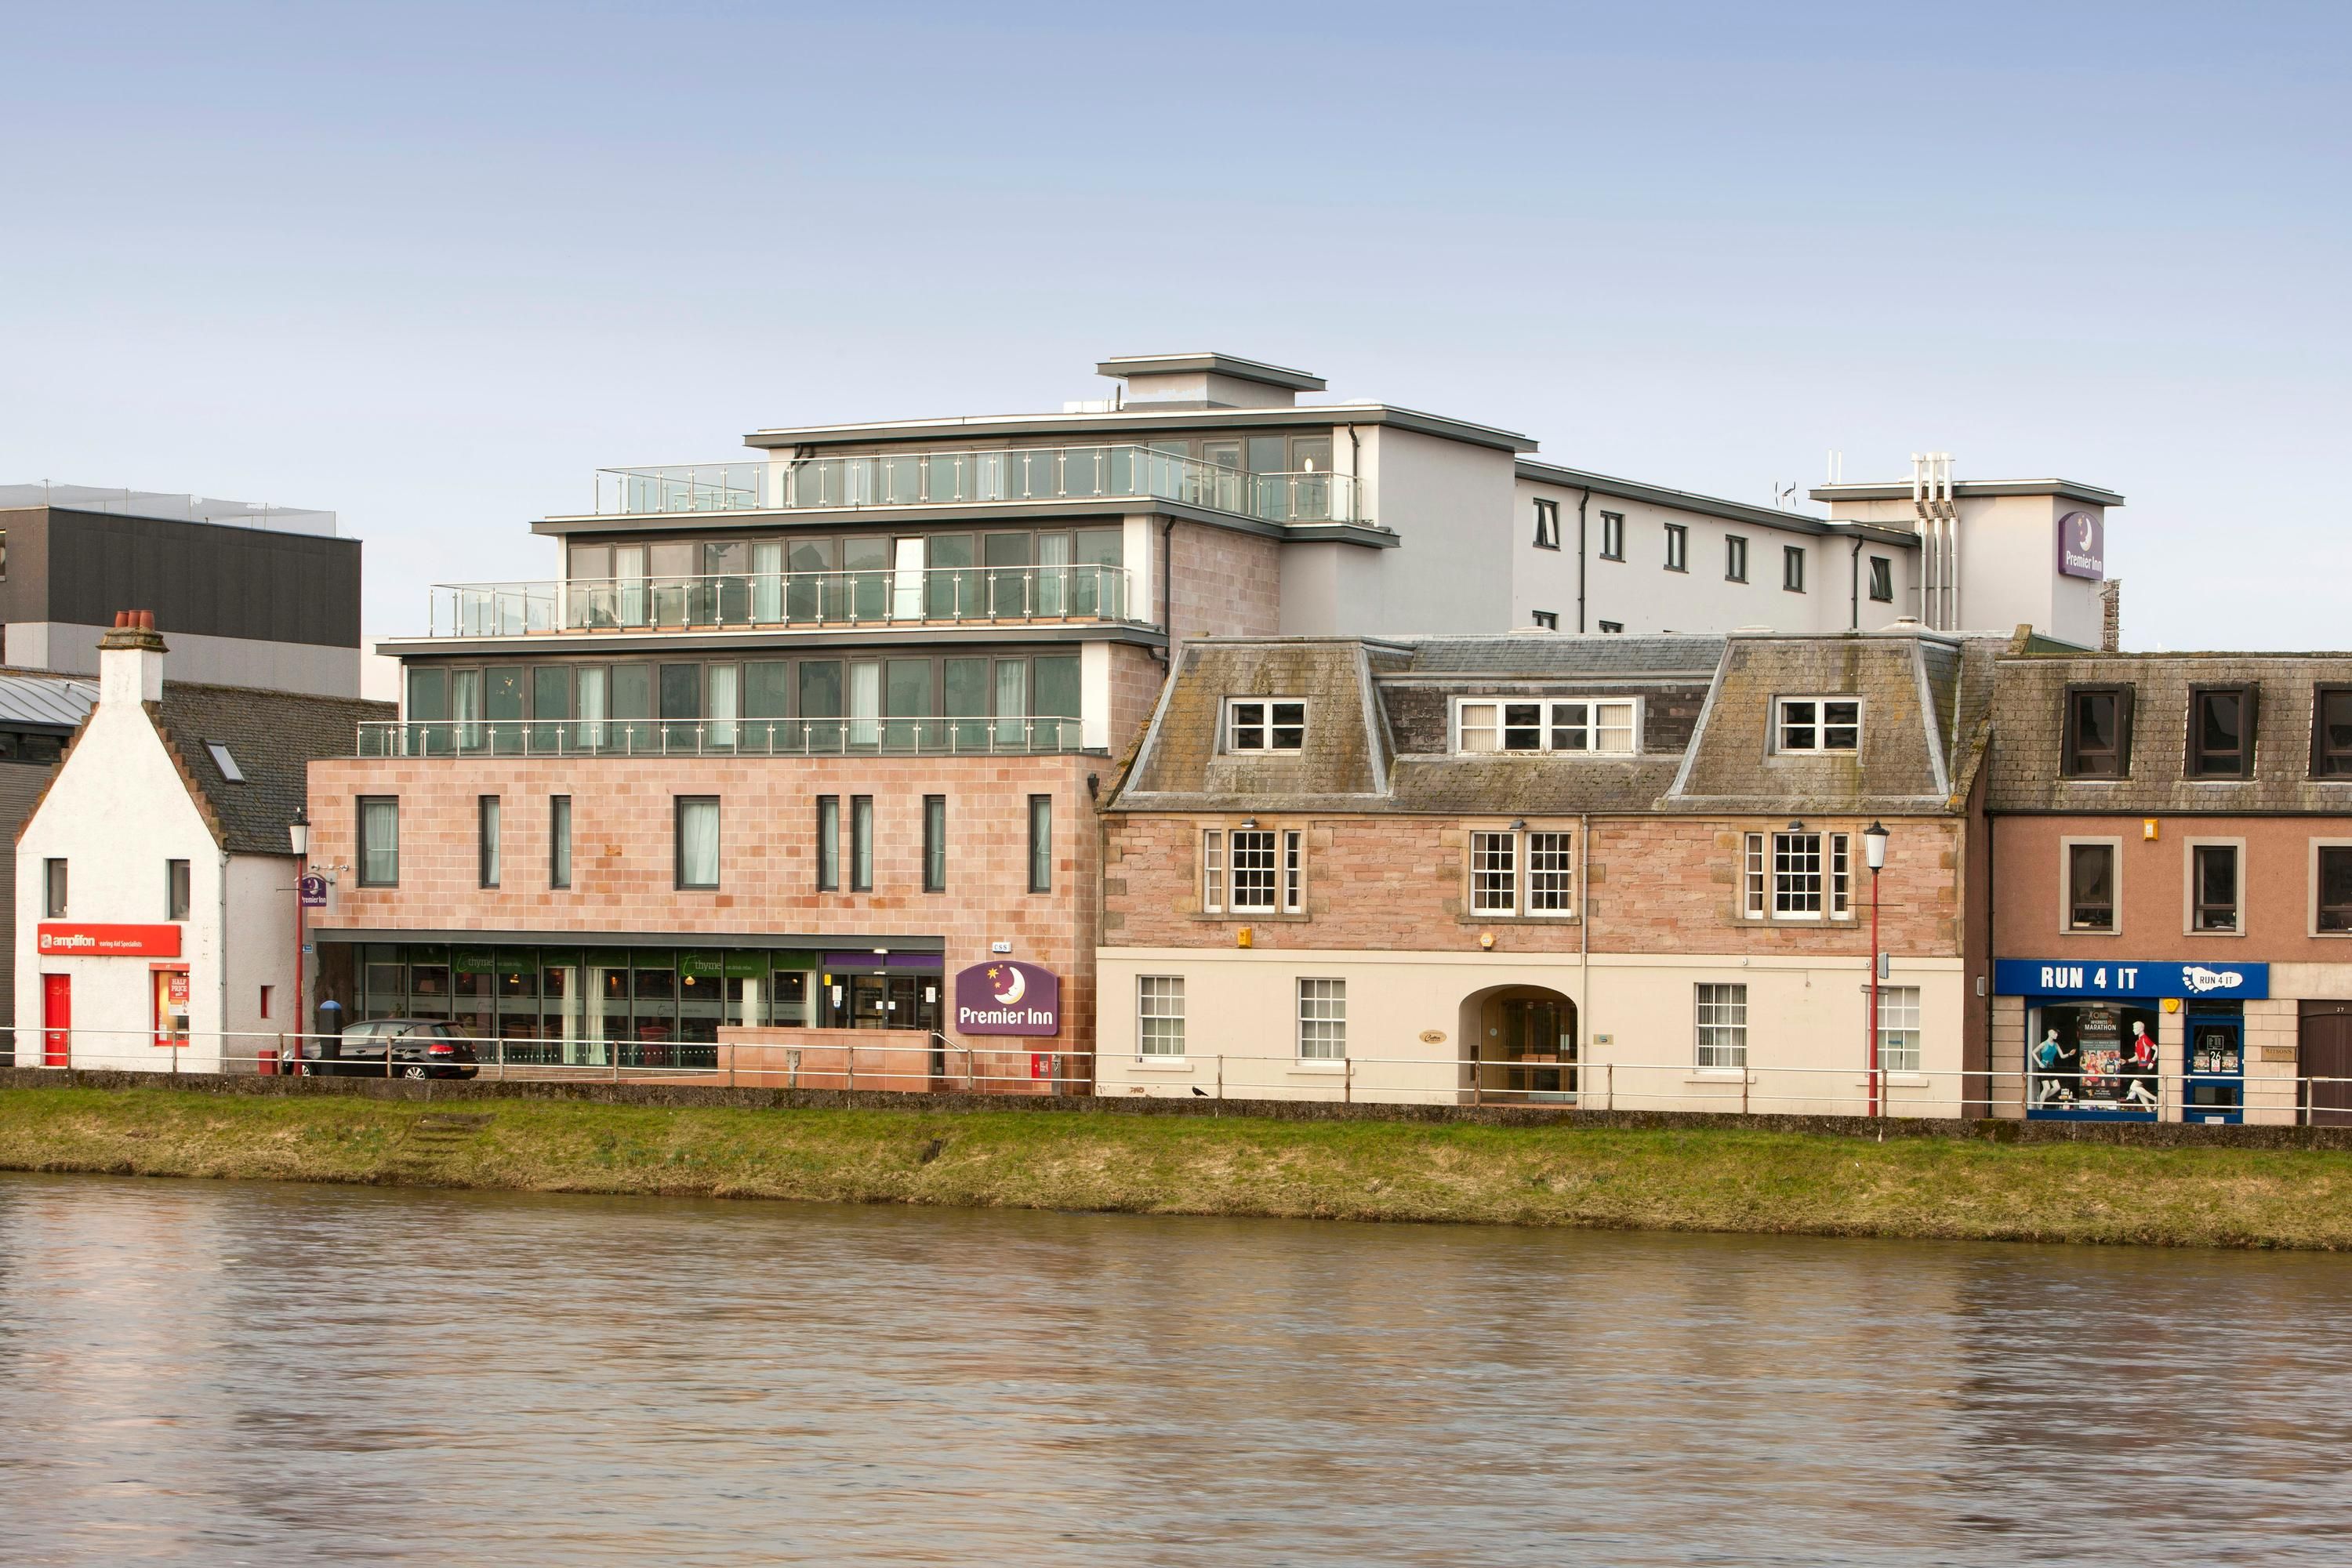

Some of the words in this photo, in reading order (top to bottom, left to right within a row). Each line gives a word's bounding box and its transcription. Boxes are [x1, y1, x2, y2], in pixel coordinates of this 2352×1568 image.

[2067, 550, 2091, 569] Premier
[2092, 556, 2102, 572] Inn
[53, 935, 95, 948] amplifon
[695, 960, 721, 971] thyme
[2042, 967, 2083, 989] RUN
[2093, 967, 2107, 989] 4
[2118, 968, 2138, 989] IT
[2226, 976, 2233, 985] IT
[960, 1007, 1025, 1024] Premier
[1028, 1007, 1053, 1025] Inn
[2210, 1051, 2221, 1061] 26
